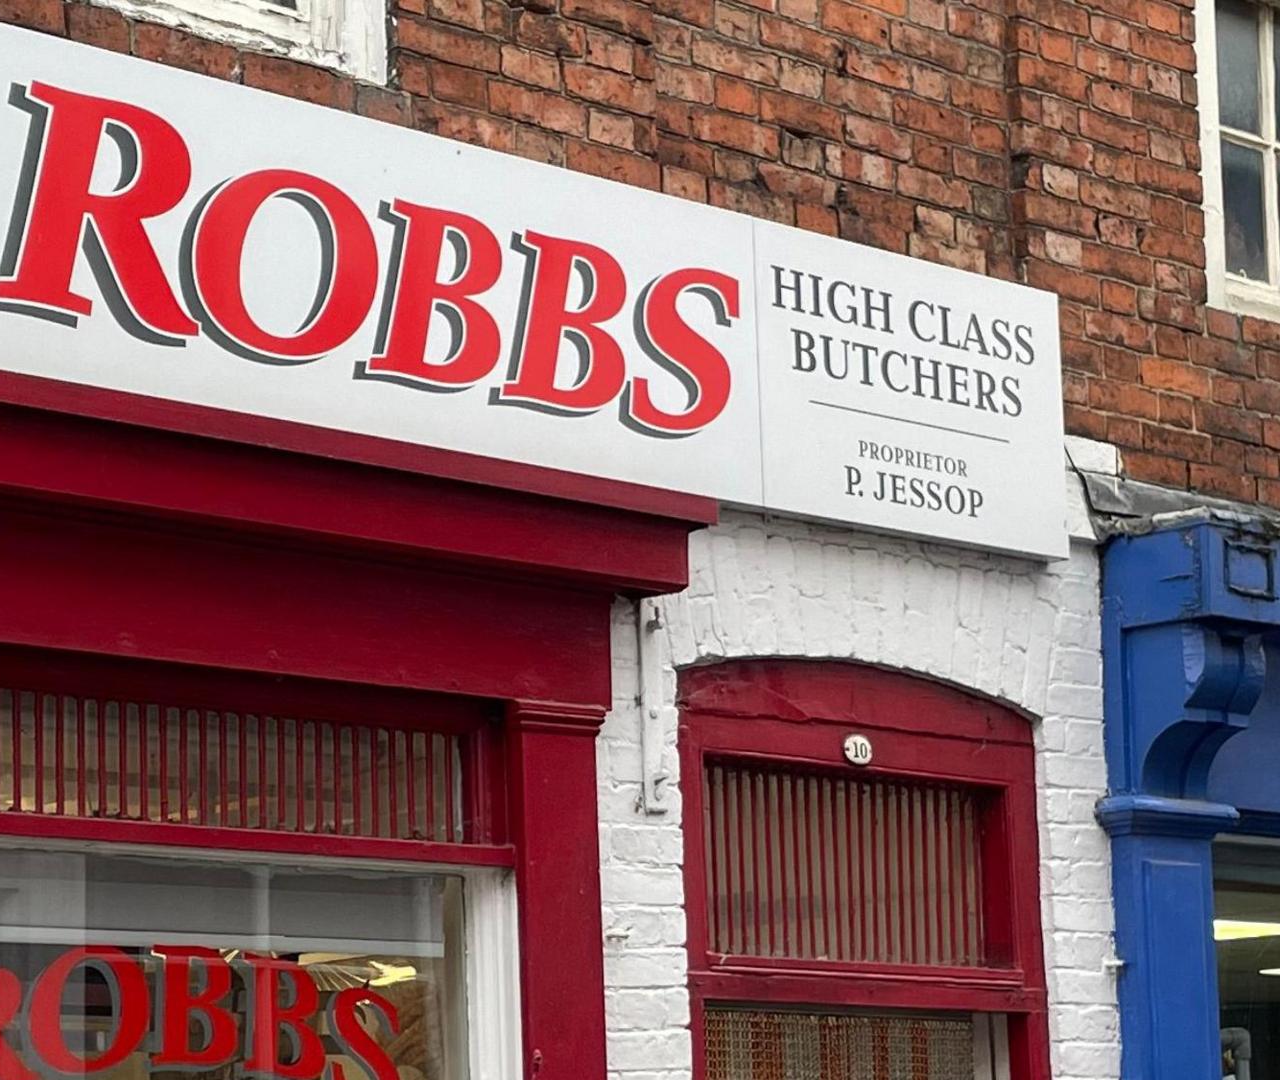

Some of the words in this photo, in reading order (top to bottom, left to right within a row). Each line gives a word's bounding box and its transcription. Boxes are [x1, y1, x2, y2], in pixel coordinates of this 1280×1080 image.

[771, 264, 892, 334] HIGH
[909, 300, 1035, 366] CLASS
[792, 328, 1023, 418] BUTCHERS
[858, 439, 969, 478] PROPRIETOR
[845, 464, 867, 498] P.
[873, 469, 984, 518] JESSOP
[853, 740, 869, 760] 10
